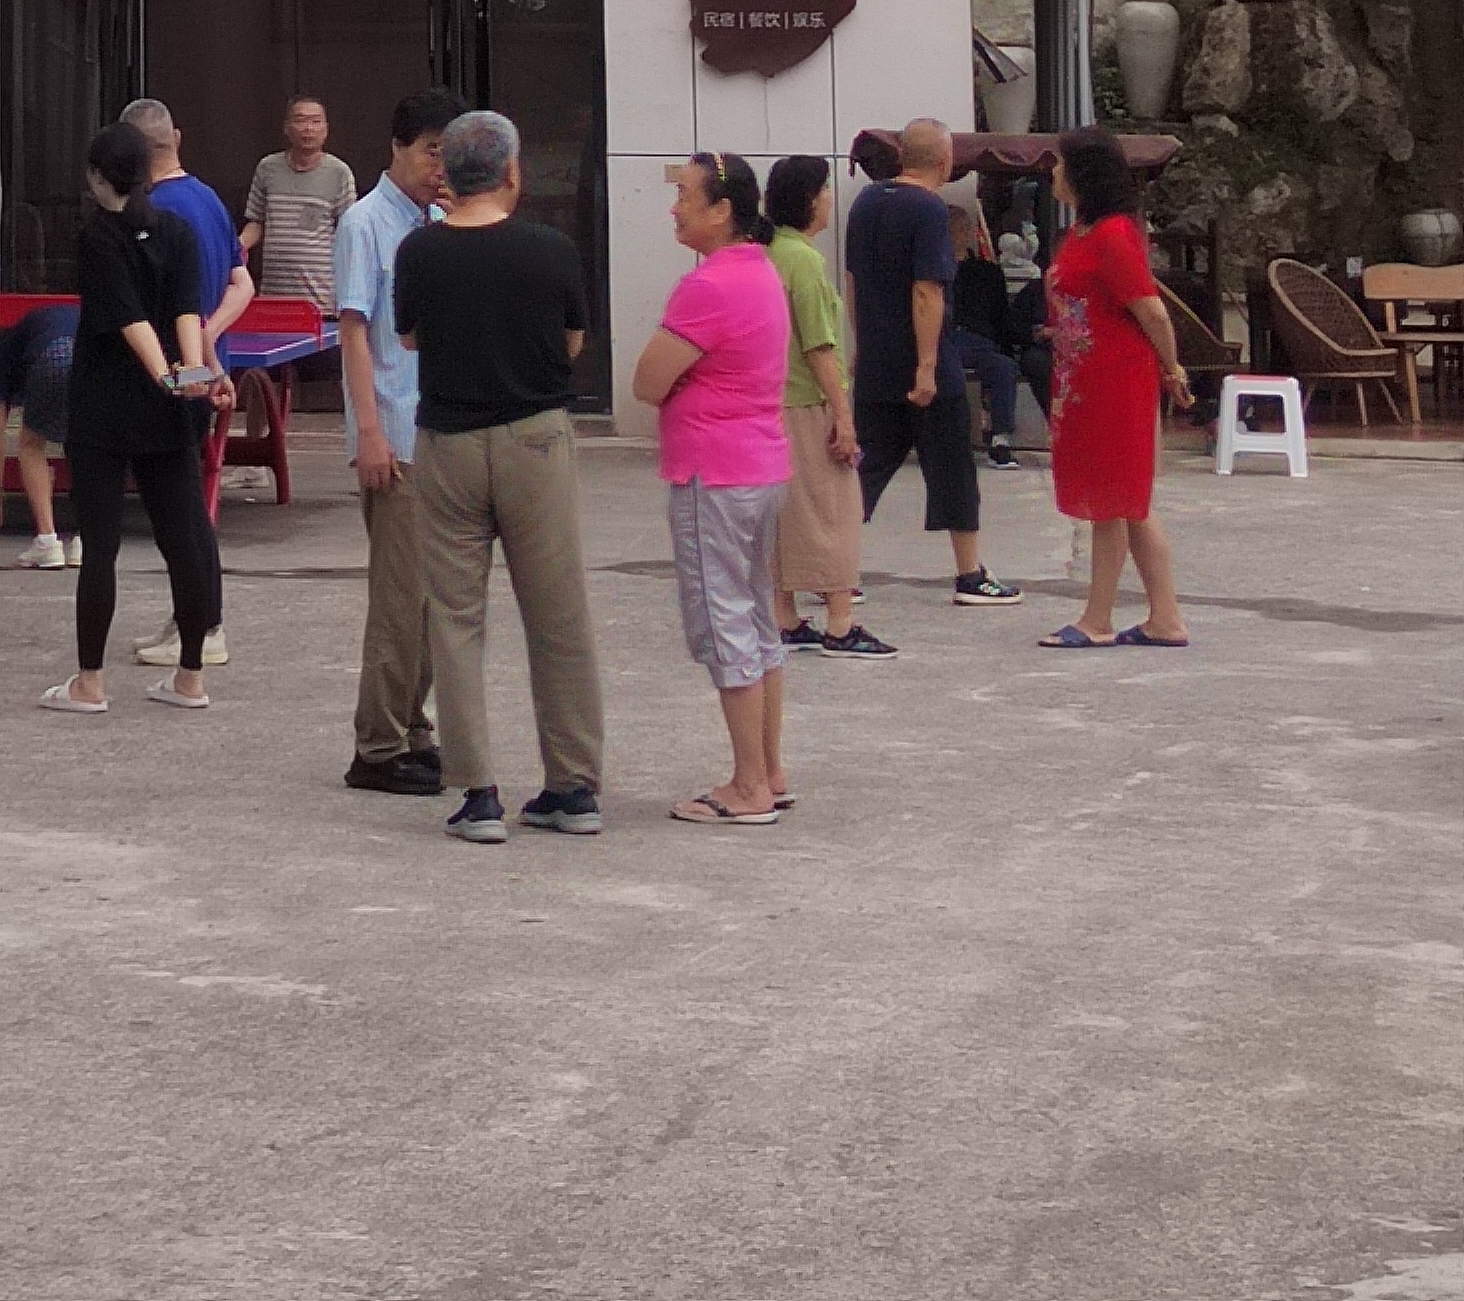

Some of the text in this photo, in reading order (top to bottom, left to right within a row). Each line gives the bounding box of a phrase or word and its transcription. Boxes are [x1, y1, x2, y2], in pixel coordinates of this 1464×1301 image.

[704, 11, 827, 28] 民宿 餐饮 娱乐
